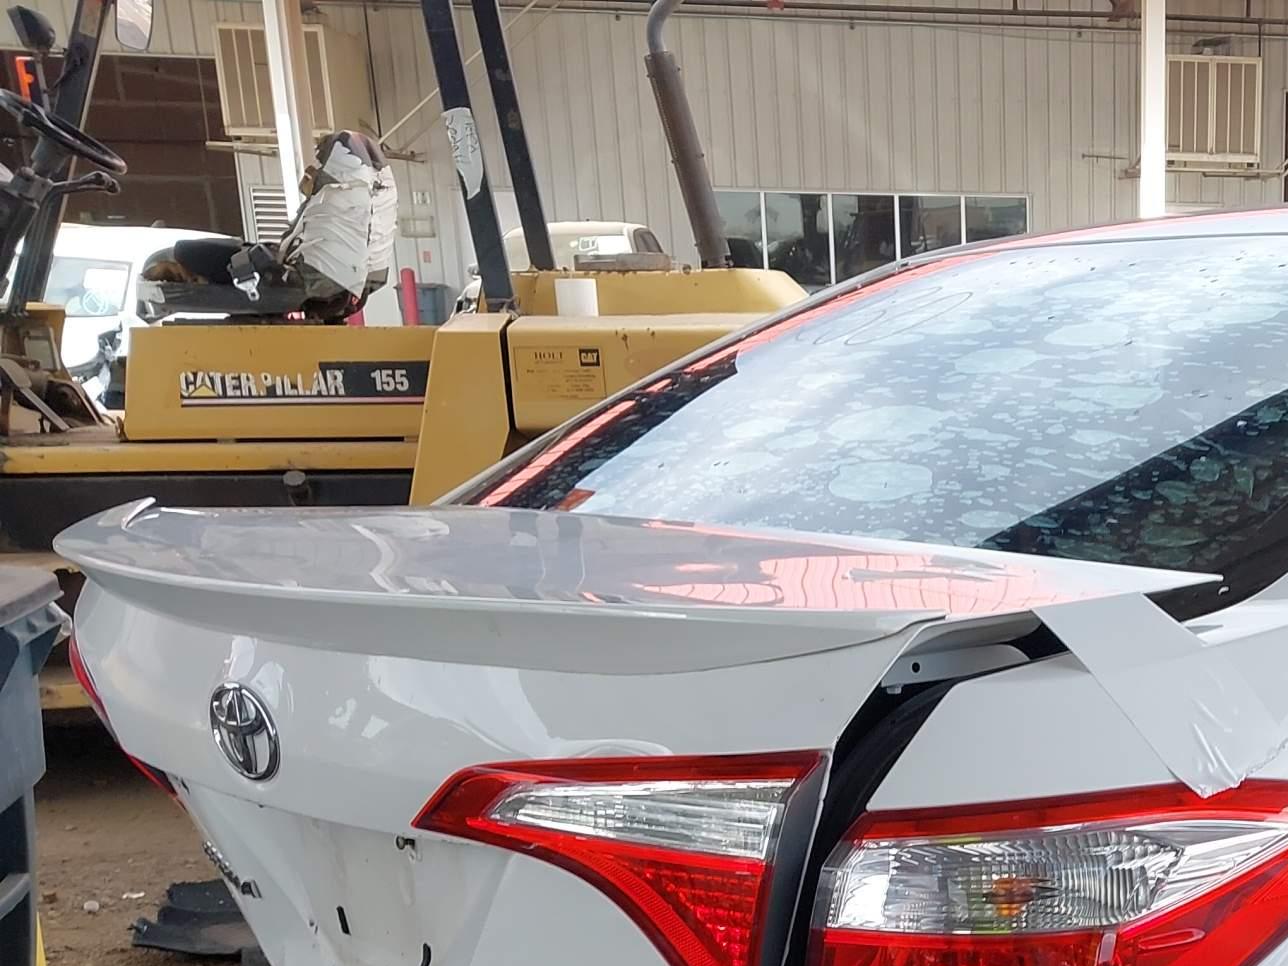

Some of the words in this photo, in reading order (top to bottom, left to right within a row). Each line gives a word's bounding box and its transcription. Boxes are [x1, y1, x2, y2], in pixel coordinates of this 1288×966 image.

[580, 352, 598, 362] CAT
[180, 369, 346, 397] CATERPILLAR
[371, 369, 409, 392] 155
